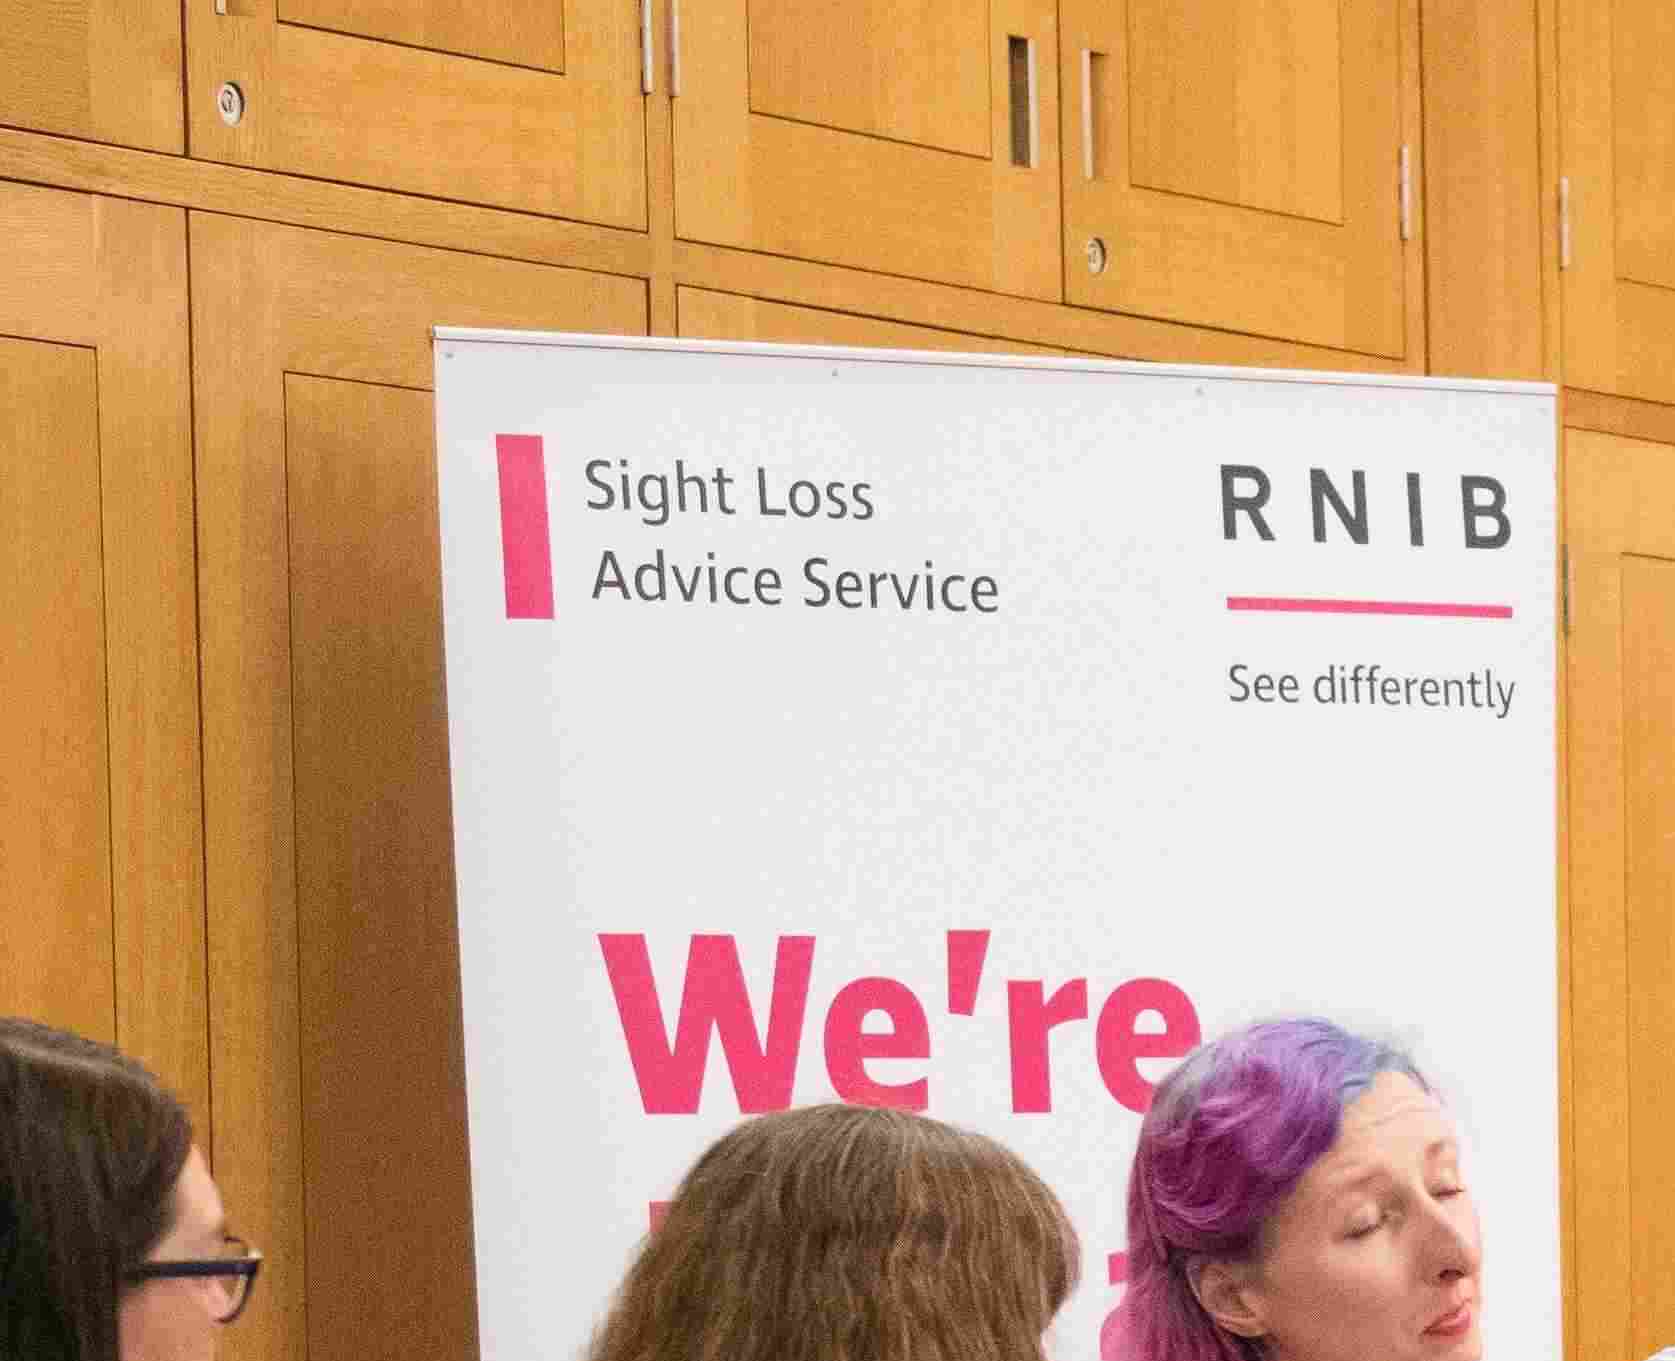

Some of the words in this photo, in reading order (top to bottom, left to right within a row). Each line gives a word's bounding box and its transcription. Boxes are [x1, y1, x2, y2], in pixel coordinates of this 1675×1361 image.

[585, 459, 736, 526] Sight
[757, 467, 873, 520] Loss
[1220, 464, 1511, 549] RNIB
[592, 549, 782, 606] Advice
[803, 557, 999, 613] Service
[1228, 664, 1299, 702] See
[1313, 664, 1515, 719] differently
[597, 930, 1203, 1114] We're
